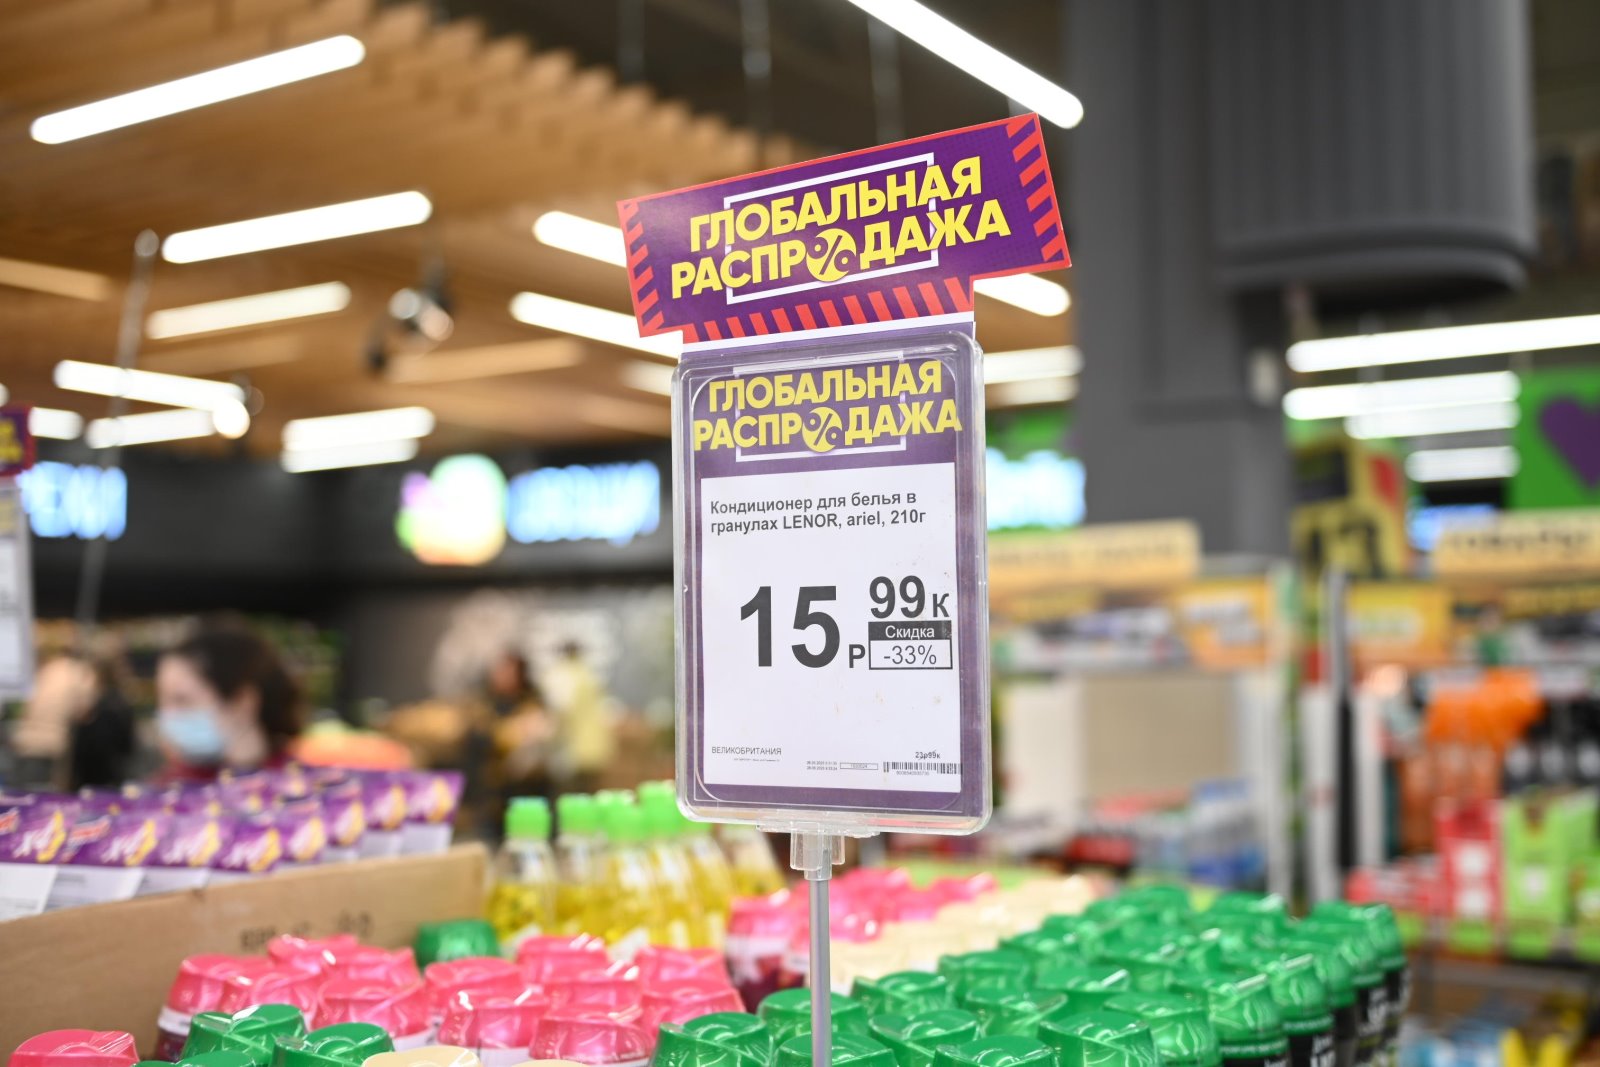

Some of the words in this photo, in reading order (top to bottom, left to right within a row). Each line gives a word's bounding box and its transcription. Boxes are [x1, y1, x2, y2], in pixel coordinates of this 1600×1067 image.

[689, 156, 982, 252] ГЛОБАЛЬНАЯ
[708, 360, 942, 412] ГЛОБАЛЬНАЯ
[710, 498, 813, 514] Кондиционер
[816, 497, 846, 511] для
[851, 491, 901, 506] белья
[906, 492, 918, 504] в
[710, 519, 778, 537] гранулах
[783, 512, 842, 530] LENOR,
[847, 509, 885, 527] ariel,
[890, 508, 926, 524] 210г
[740, 585, 841, 669] 15
[885, 625, 935, 641] Скидка
[883, 644, 937, 665] -33%
[711, 746, 782, 756] ВЕЛИКОБРИТАНИЯ
